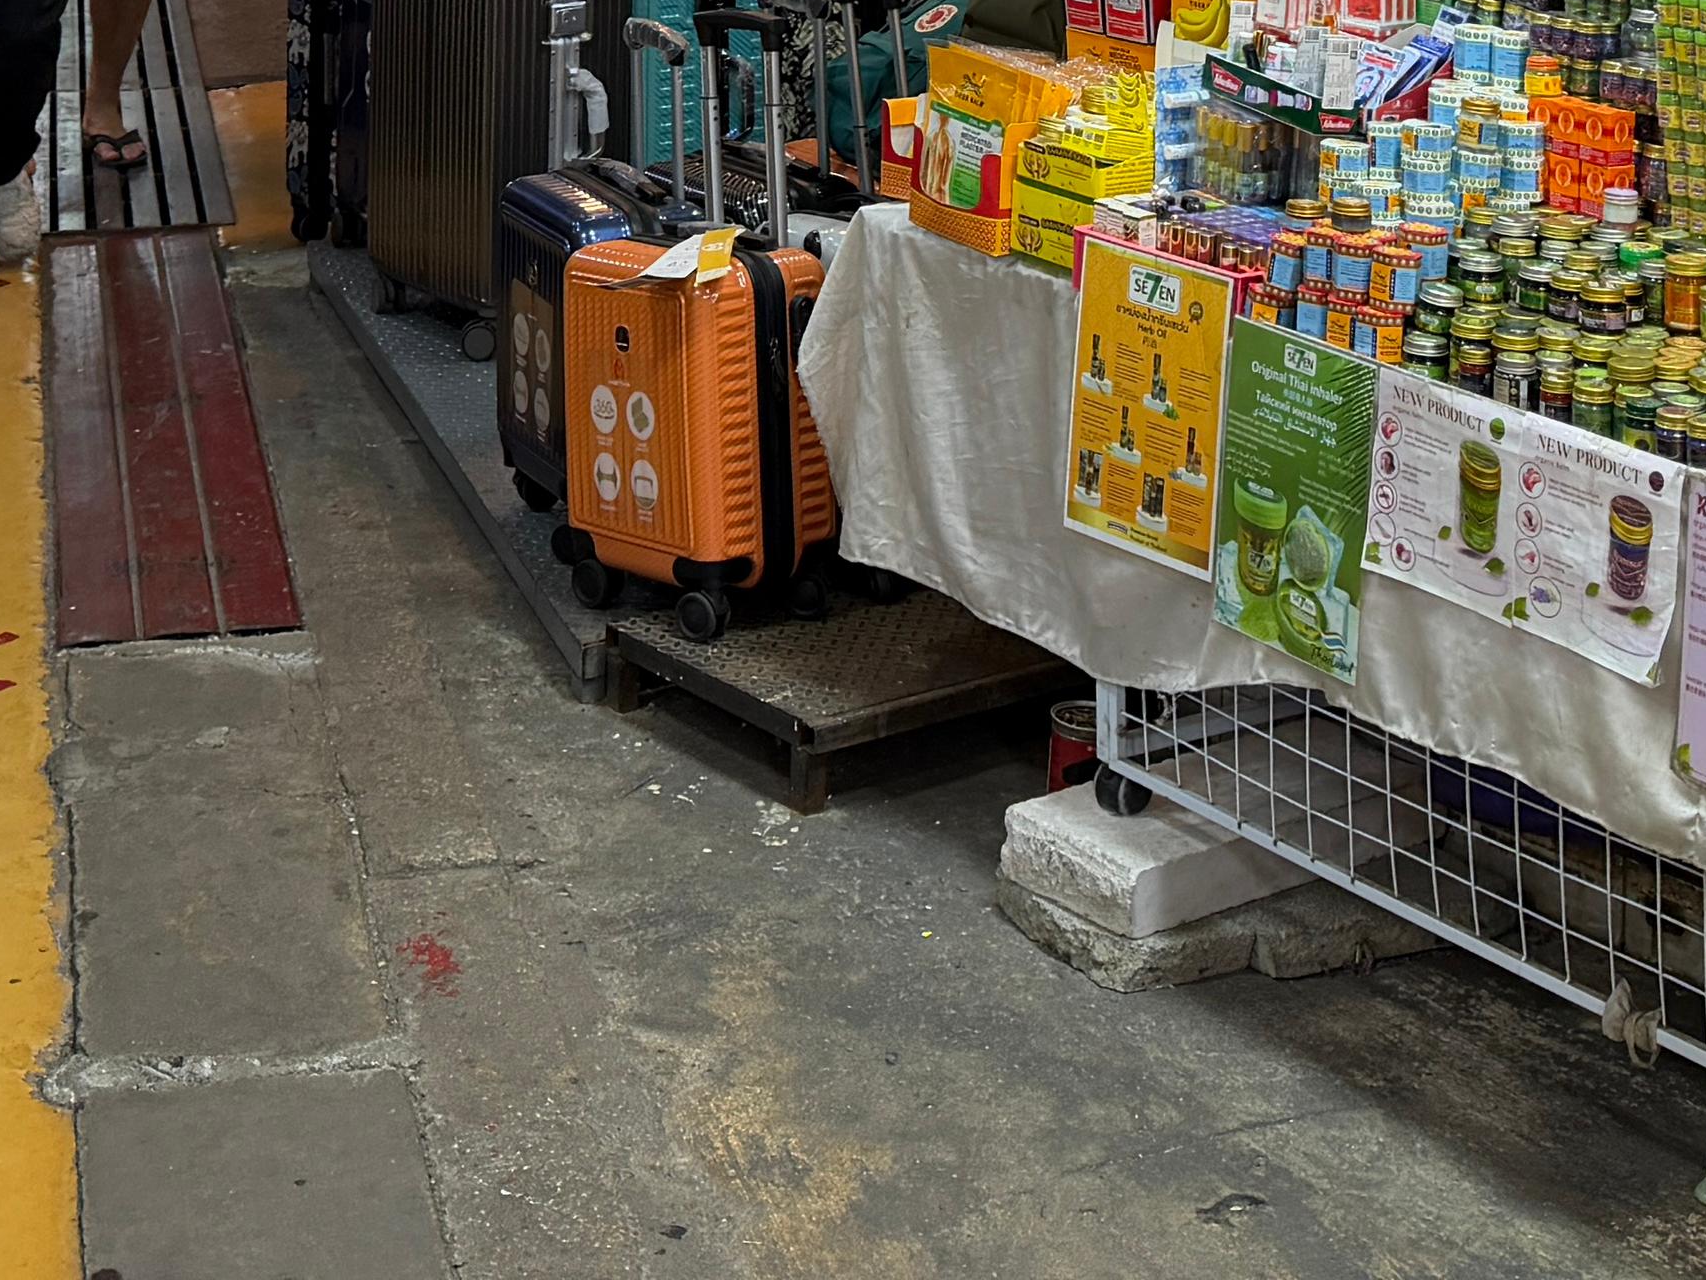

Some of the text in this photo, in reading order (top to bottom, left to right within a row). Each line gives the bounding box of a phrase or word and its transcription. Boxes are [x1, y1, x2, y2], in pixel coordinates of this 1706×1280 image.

[1137, 322, 1167, 339] Herb Oil
[1251, 360, 1287, 384] Original
[1289, 374, 1308, 392] Thai
[1394, 384, 1486, 433] NEW PRODUCT
[1536, 432, 1643, 485] NEW PRODUCT
